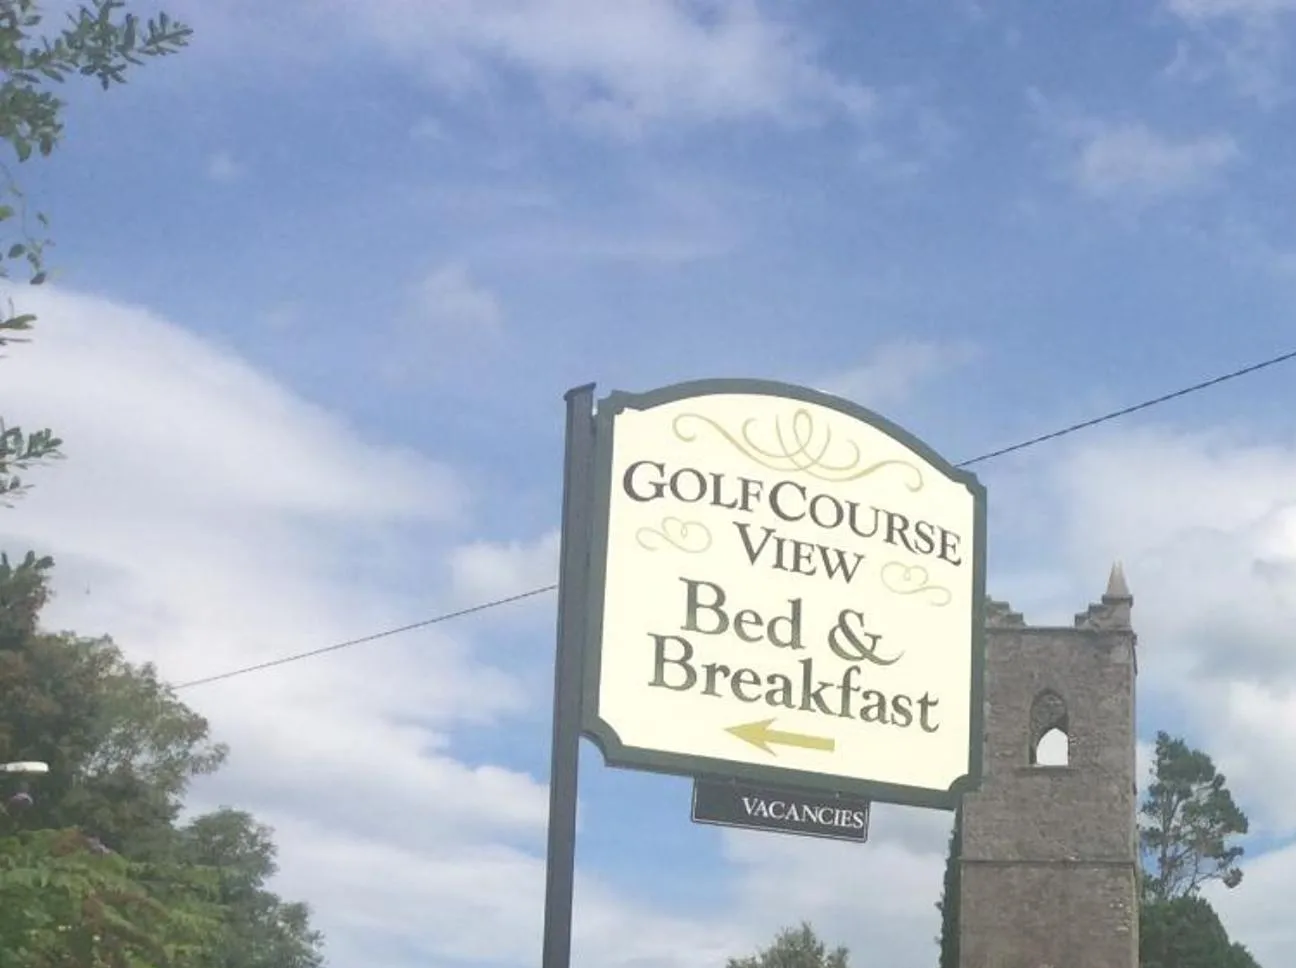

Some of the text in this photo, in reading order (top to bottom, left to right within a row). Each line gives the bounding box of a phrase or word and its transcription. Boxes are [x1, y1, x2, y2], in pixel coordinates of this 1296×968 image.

[733, 521, 865, 584] VIEW
[679, 577, 905, 665] Bed &
[647, 632, 940, 733] Breakfast
[741, 797, 865, 829] VACANCIES
